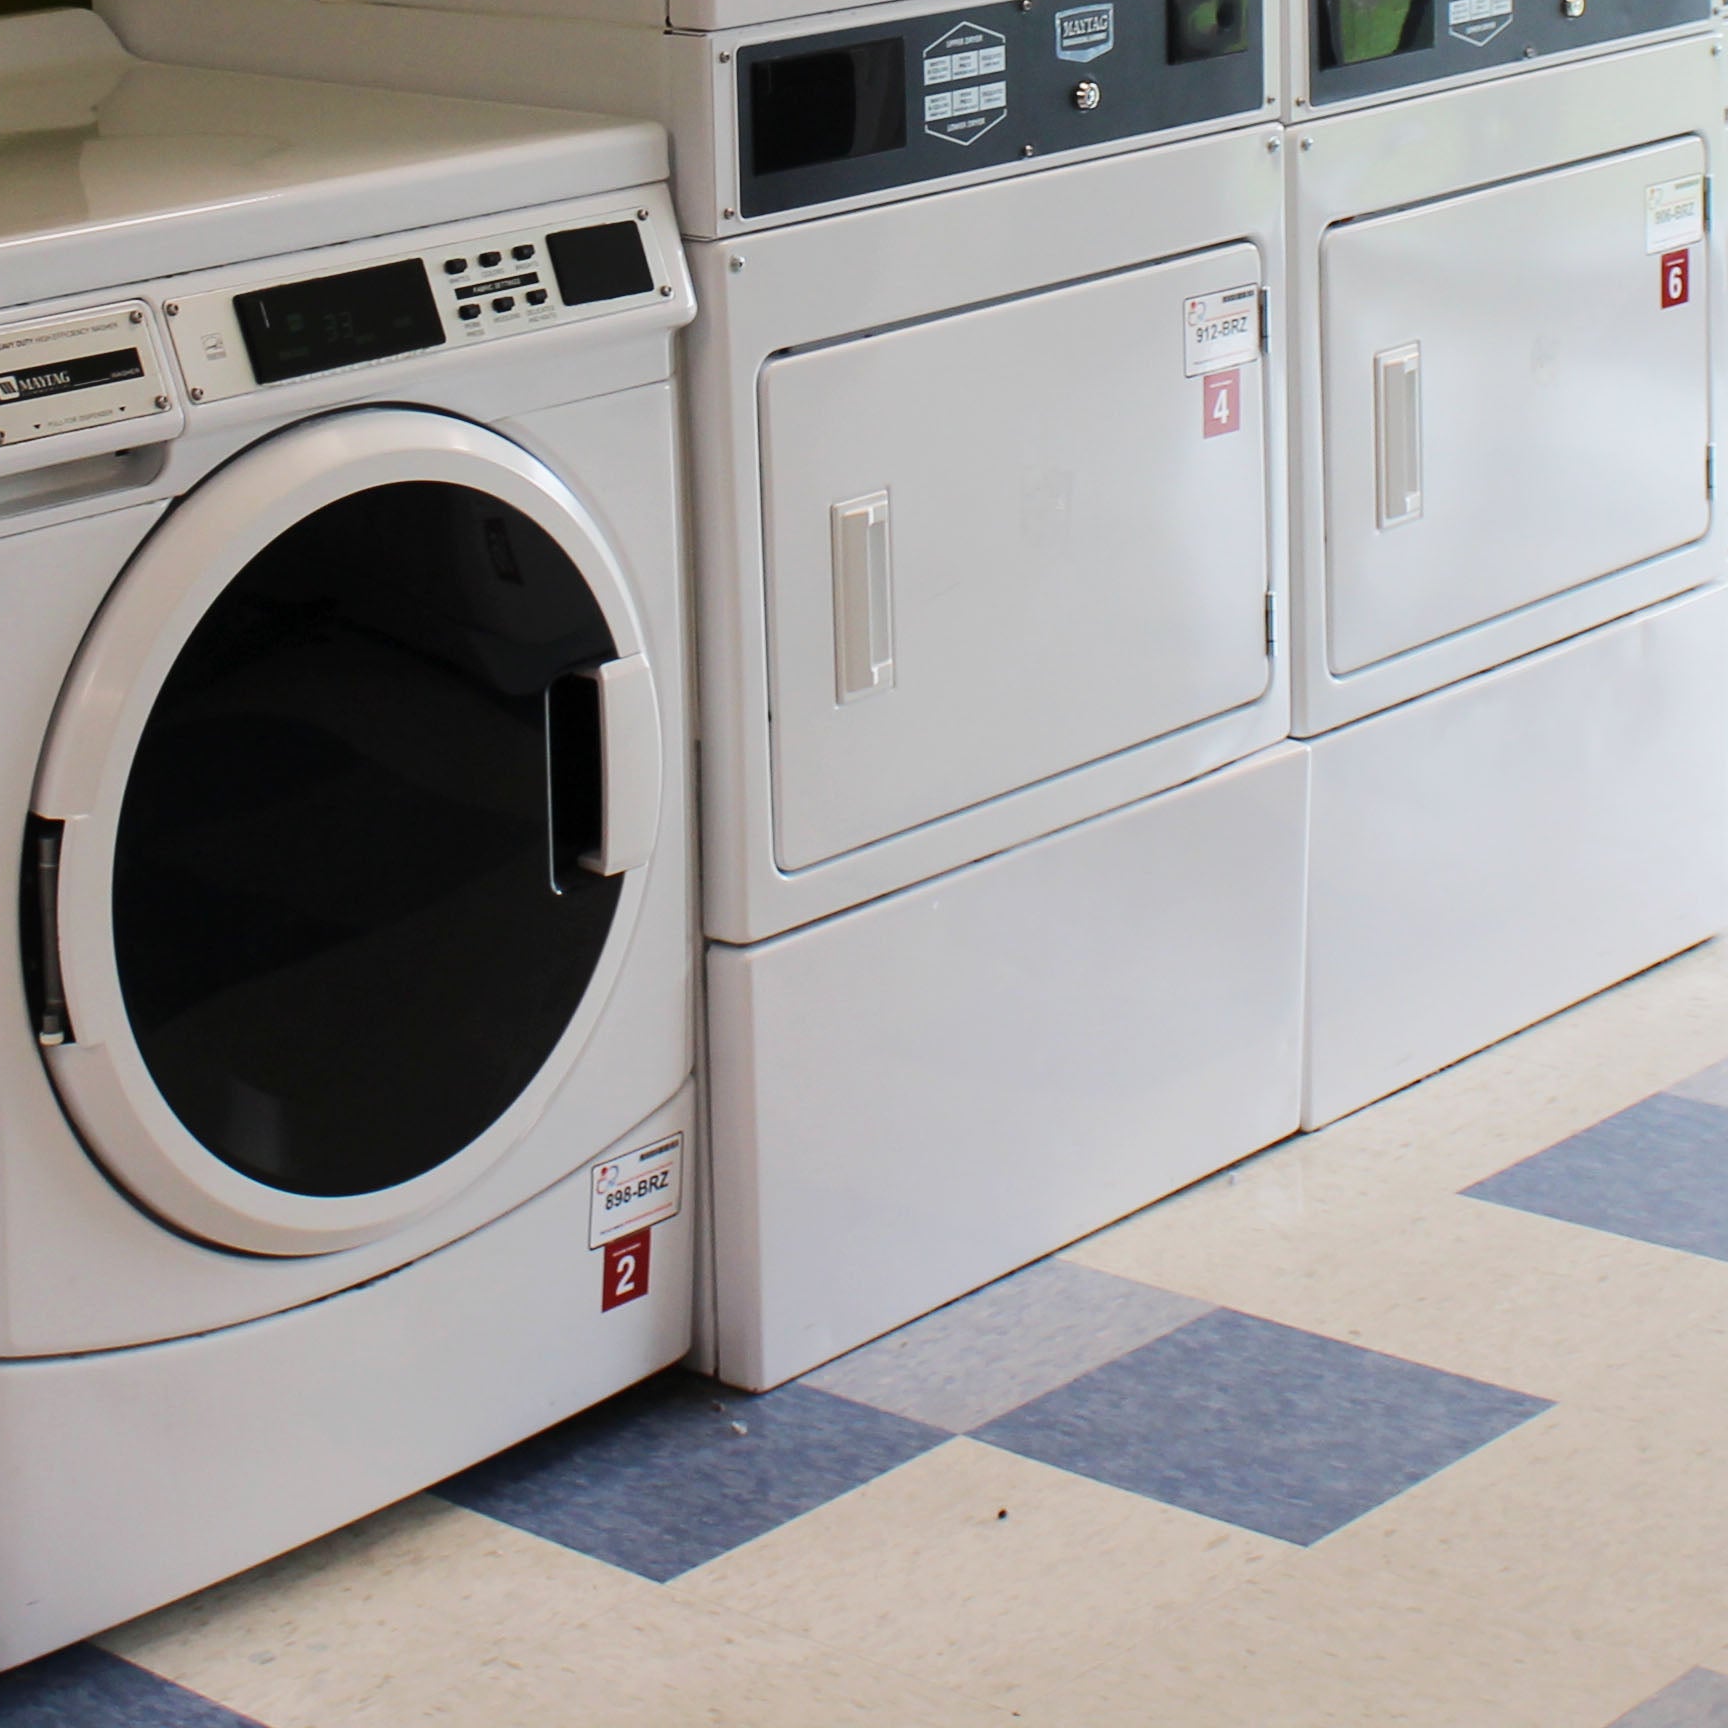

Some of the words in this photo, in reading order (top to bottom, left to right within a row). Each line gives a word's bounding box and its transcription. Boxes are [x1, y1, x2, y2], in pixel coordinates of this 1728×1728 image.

[1062, 14, 1108, 39] MAYTAG
[1668, 266, 1683, 300] 6
[15, 338, 33, 347] DUTY
[1195, 316, 1248, 344] 912-BRZ
[18, 372, 71, 392] MAYTAG
[1212, 389, 1230, 424] 4
[605, 1169, 670, 1211] 898-BRZ
[615, 1254, 637, 1297] 2
